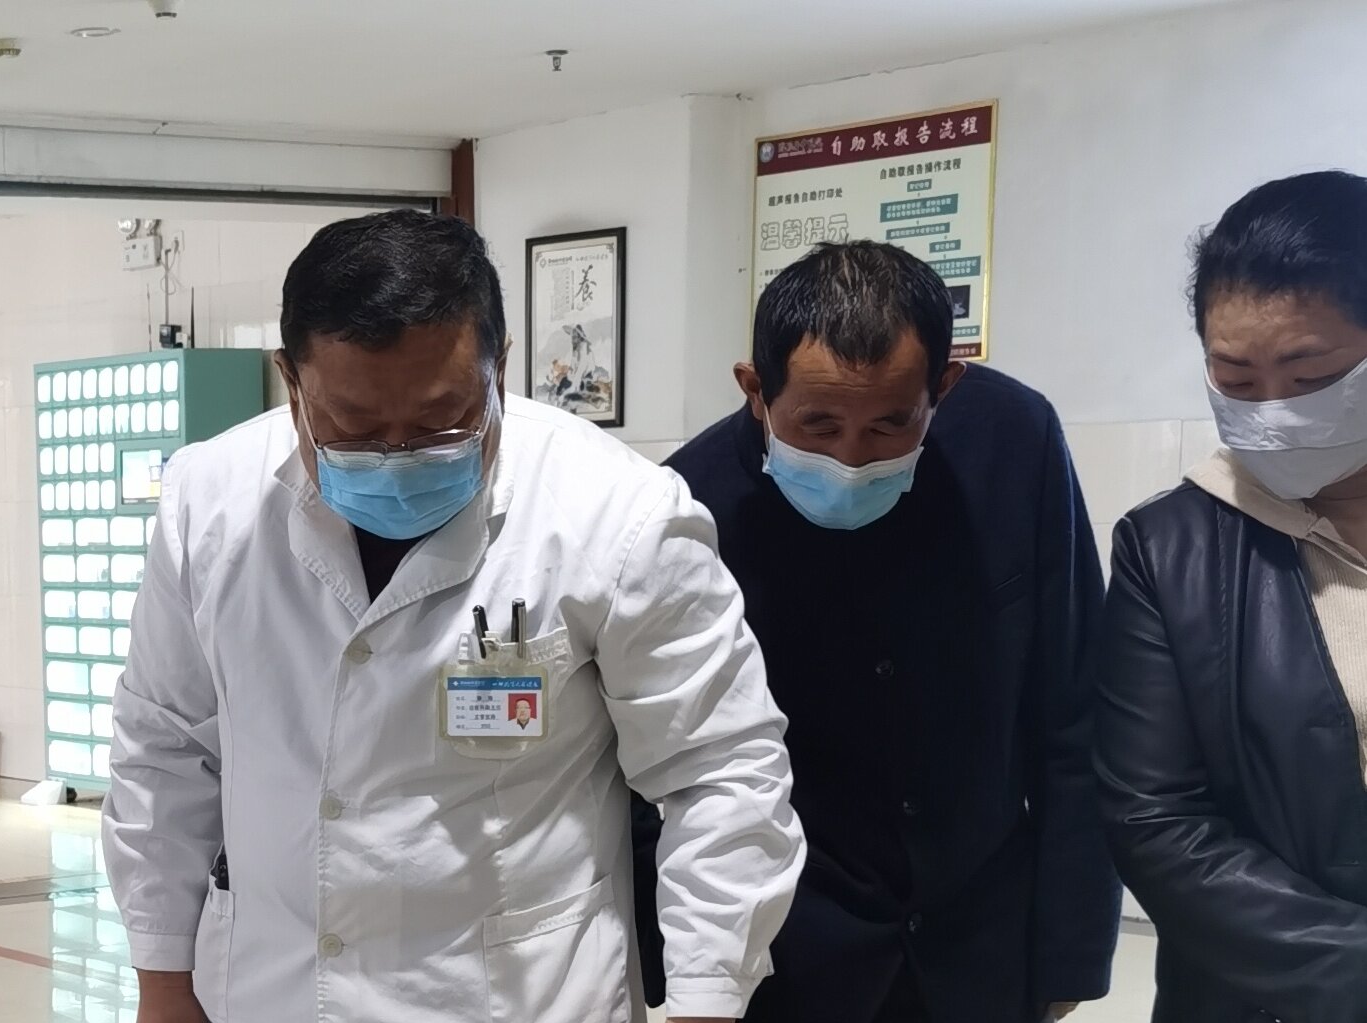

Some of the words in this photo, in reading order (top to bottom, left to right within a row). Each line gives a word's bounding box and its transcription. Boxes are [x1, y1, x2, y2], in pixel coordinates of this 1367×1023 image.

[830, 115, 979, 156] 自助取报告流程
[880, 158, 962, 180] 自助取报告操作流程
[760, 213, 850, 251] 温馨提示
